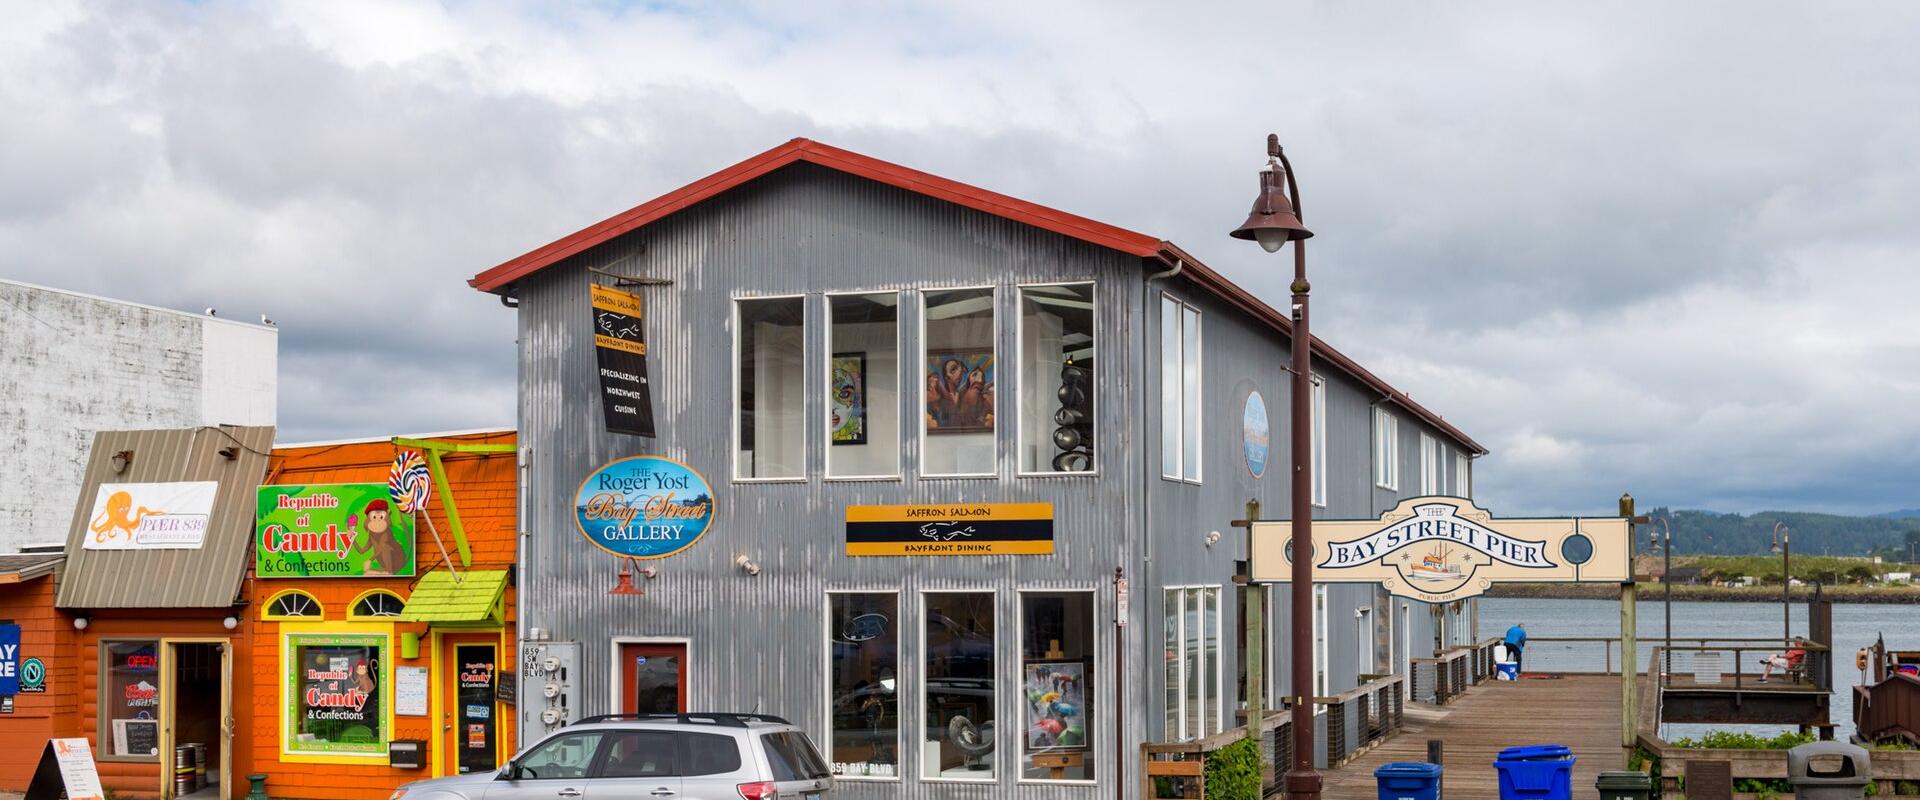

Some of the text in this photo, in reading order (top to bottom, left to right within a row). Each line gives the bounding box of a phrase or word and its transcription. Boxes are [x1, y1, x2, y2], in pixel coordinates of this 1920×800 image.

[593, 293, 640, 311] SAFFRON SALMON
[596, 337, 645, 353] BAYFRONT DINING
[600, 367, 647, 384] SPECIALIZING IN
[606, 386, 641, 399] NORTHWEST
[614, 404, 637, 415] CUISINE
[631, 467, 651, 477] THE
[598, 471, 689, 495] Roger Yost
[278, 493, 338, 511] Republic
[585, 491, 706, 529] Bay Street
[906, 508, 991, 517] SAFFRON SALMON
[142, 517, 205, 531] PIER 839
[296, 513, 310, 527] of
[603, 525, 684, 541] GALLERY
[263, 523, 357, 559] Candy
[1337, 519, 1538, 564] BAY STREET PIER
[904, 544, 992, 552] BAYFRONT DINING
[264, 559, 350, 573] & Confections
[1418, 593, 1456, 601] PUBLIC PIER
[524, 647, 540, 656] 859
[127, 655, 157, 668] OPEN
[524, 662, 539, 670] BAY
[308, 669, 348, 681] Republic
[461, 672, 491, 683] Candy
[328, 681, 338, 691] of
[306, 687, 369, 712] Candy
[307, 709, 364, 720] & Confections
[831, 762, 847, 773] 859
[849, 763, 866, 773] BAY
